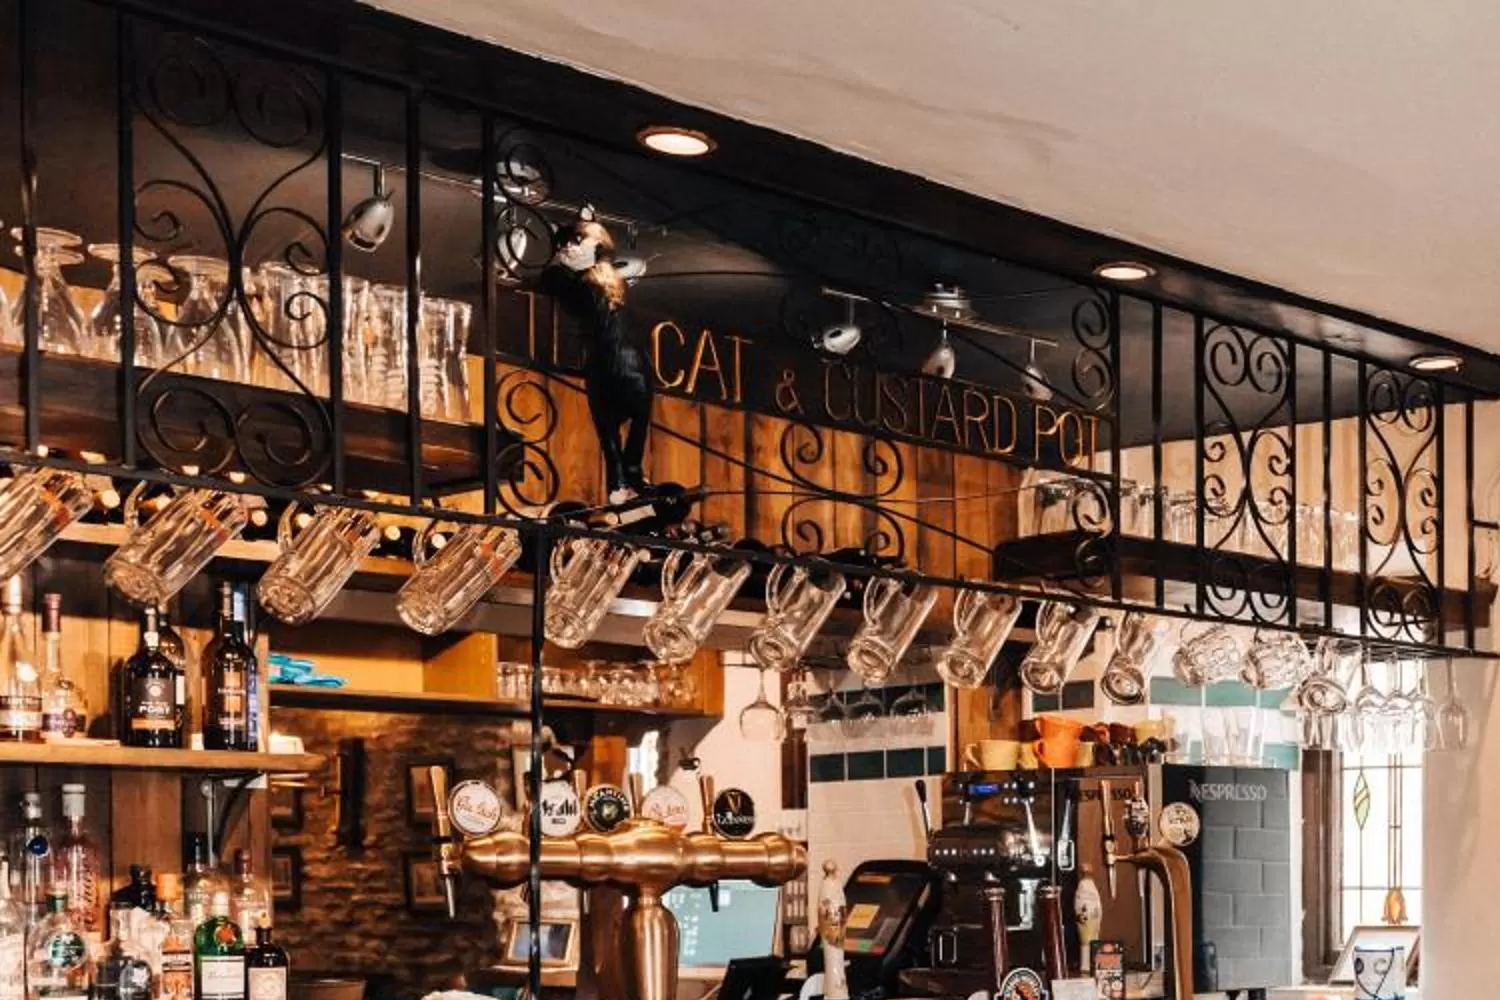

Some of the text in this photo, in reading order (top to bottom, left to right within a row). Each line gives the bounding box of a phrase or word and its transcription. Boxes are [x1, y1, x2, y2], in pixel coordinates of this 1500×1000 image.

[651, 320, 754, 403] CAT
[775, 367, 805, 415] &
[823, 361, 1018, 455] CUSTARD
[1034, 402, 1101, 467] POT
[1188, 779, 1268, 801] NESPRESSO
